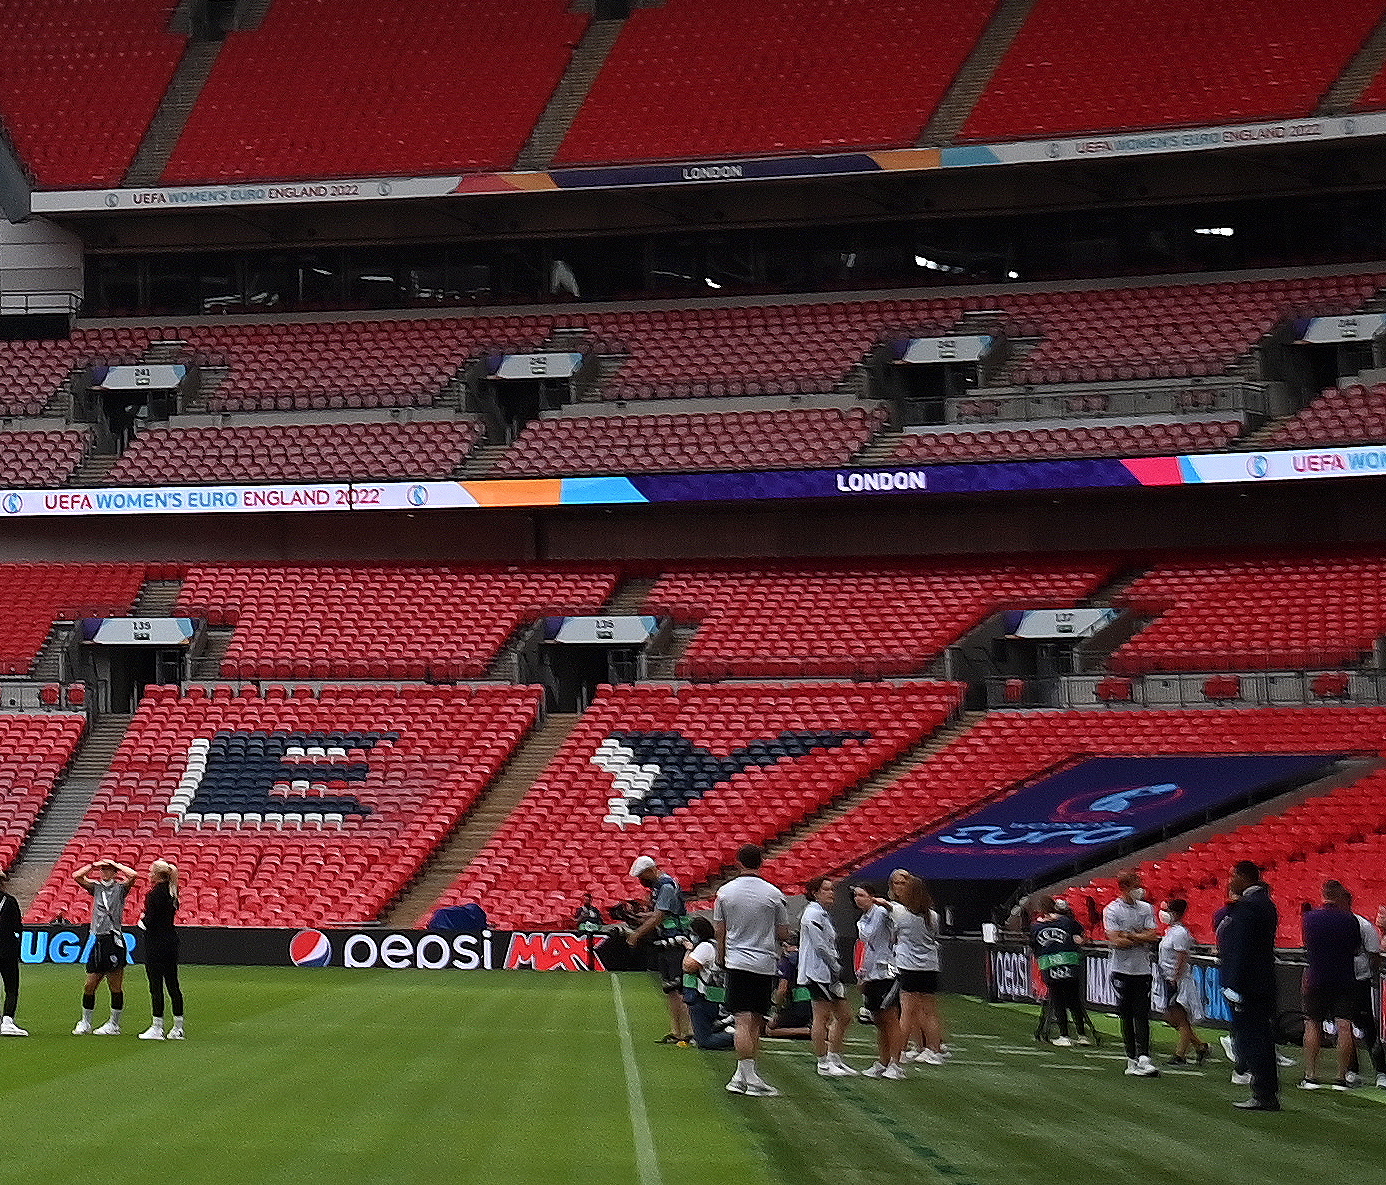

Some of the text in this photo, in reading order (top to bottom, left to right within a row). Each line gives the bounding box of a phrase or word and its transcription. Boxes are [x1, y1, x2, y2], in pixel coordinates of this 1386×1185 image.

[1076, 141, 1113, 154] UEFA
[1222, 127, 1285, 144] ENGLAND
[683, 165, 743, 180] LONDON
[133, 184, 359, 205] UEFA WOMEN'S EURO ENGLAND 2022
[1292, 454, 1346, 472] UEFA
[836, 471, 927, 492] LONDON
[44, 489, 379, 510] UEFA WOMEN'S EURO ENGLAND 2022
[343, 929, 613, 972] pepsi MAX
